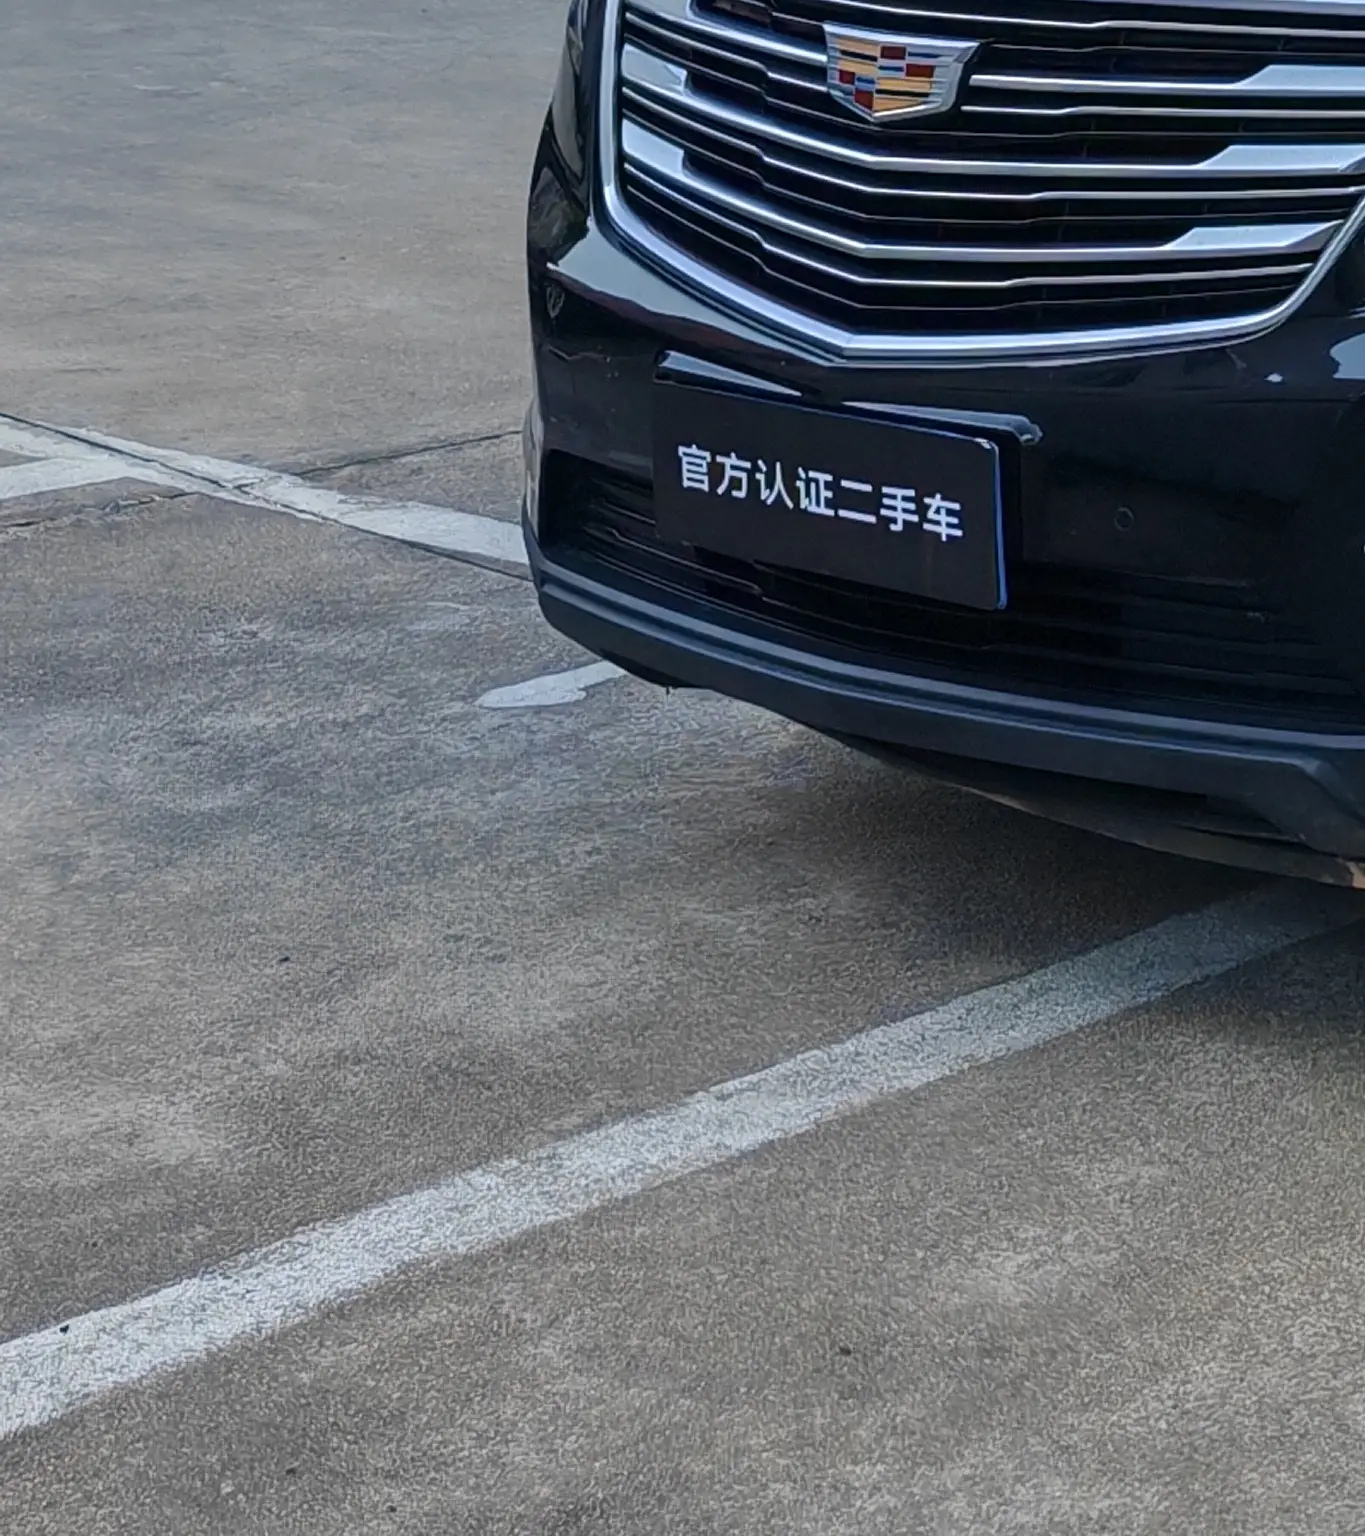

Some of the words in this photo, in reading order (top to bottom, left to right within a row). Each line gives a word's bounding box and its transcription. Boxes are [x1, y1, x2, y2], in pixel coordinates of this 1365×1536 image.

[677, 443, 964, 542] 官方认证二手车
